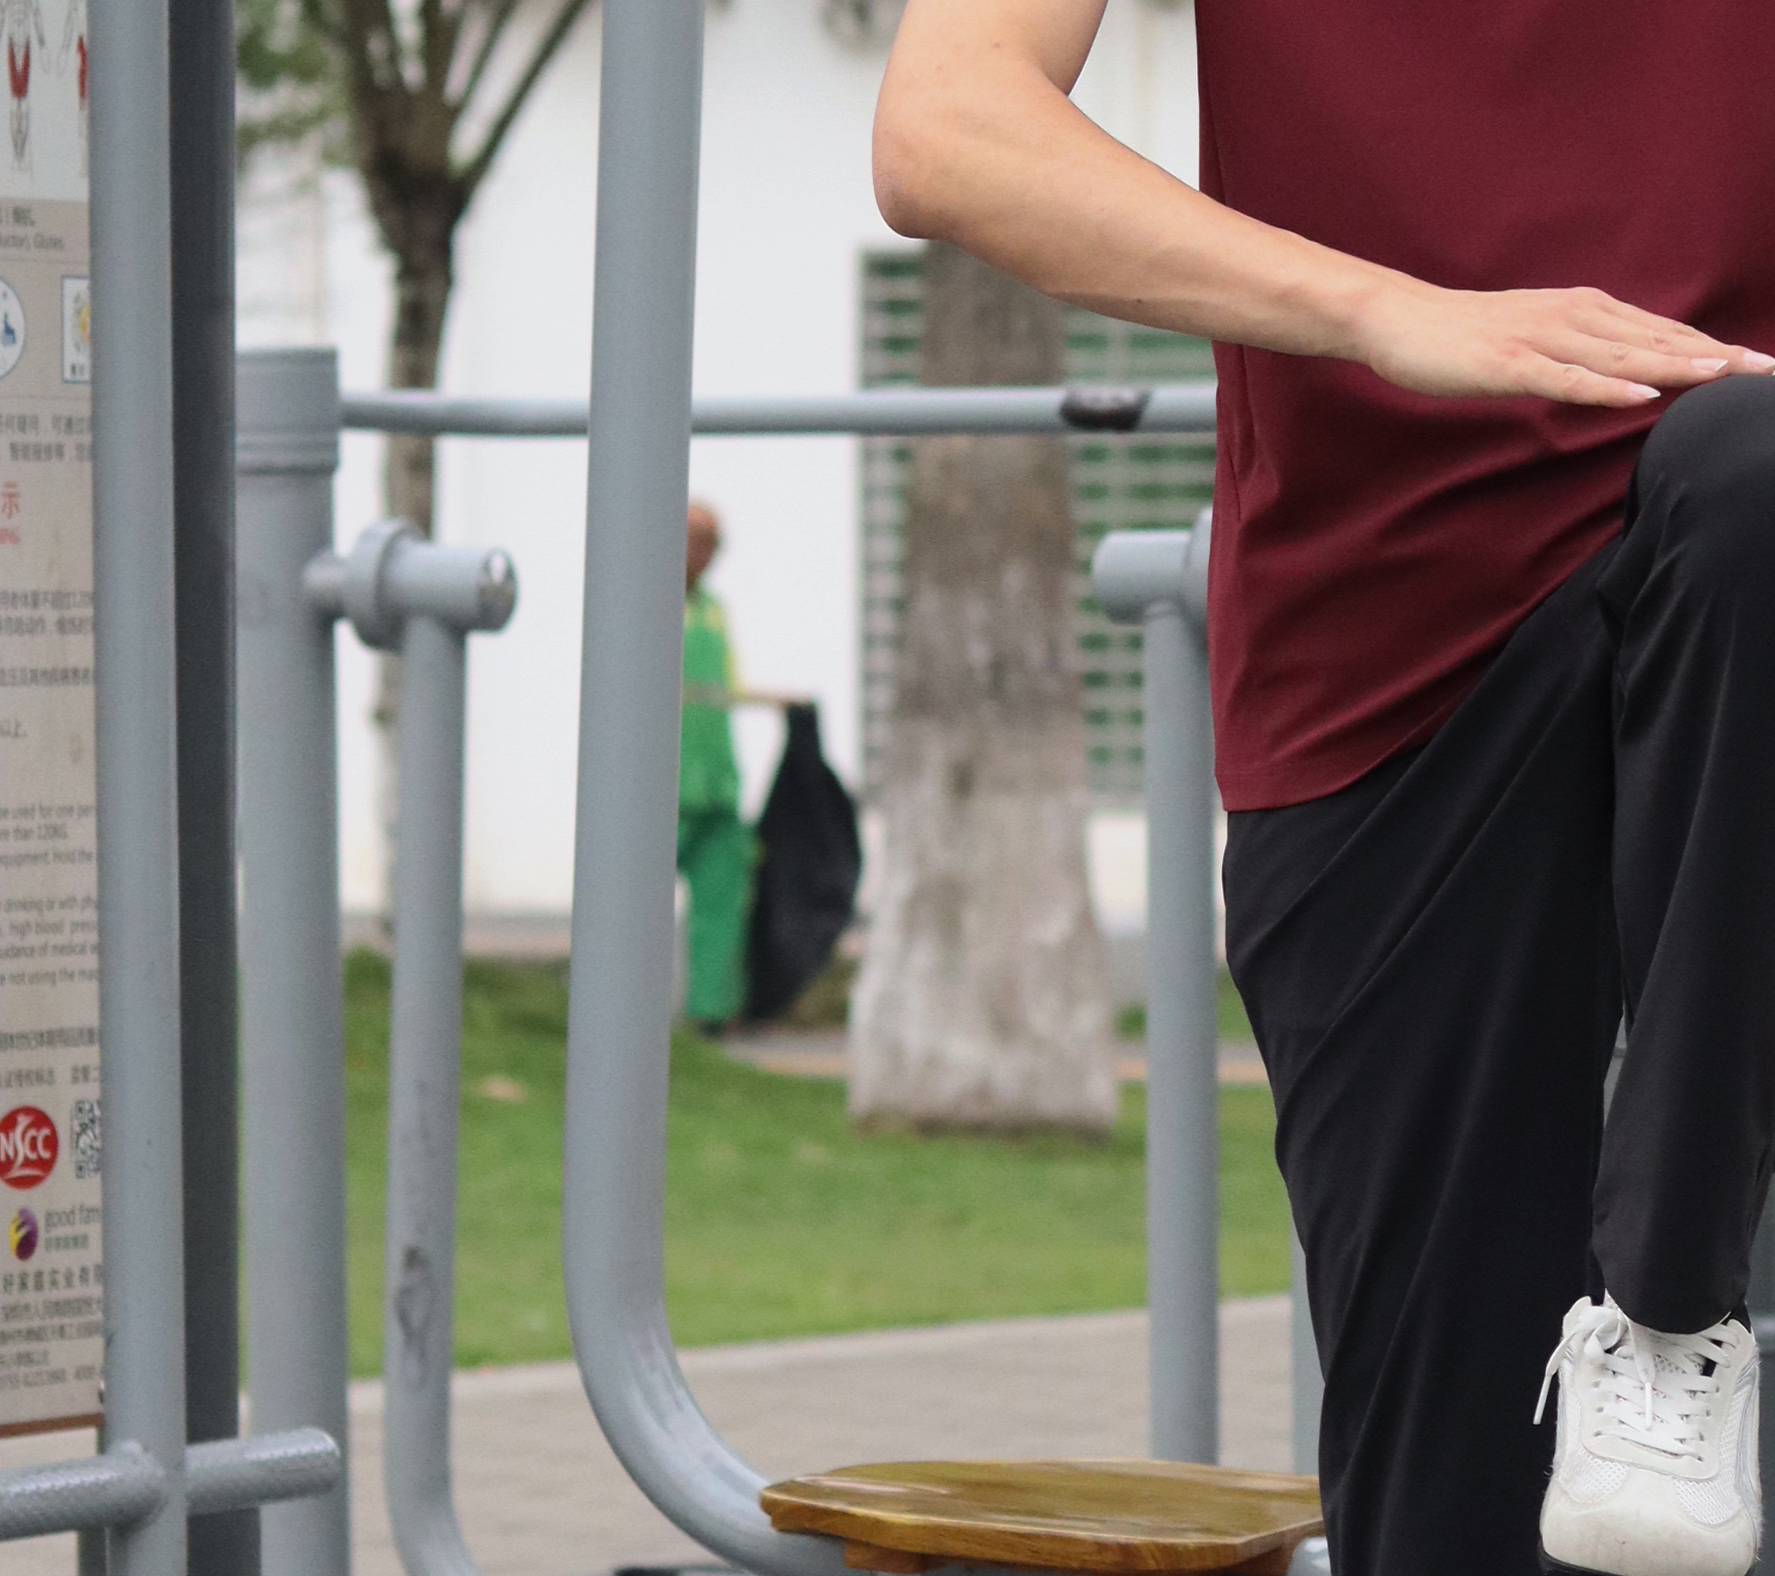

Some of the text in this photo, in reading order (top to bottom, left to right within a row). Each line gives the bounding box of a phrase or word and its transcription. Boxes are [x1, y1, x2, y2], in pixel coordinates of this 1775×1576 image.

[2, 481, 20, 520] 示
[44, 1203, 101, 1233] good fam
